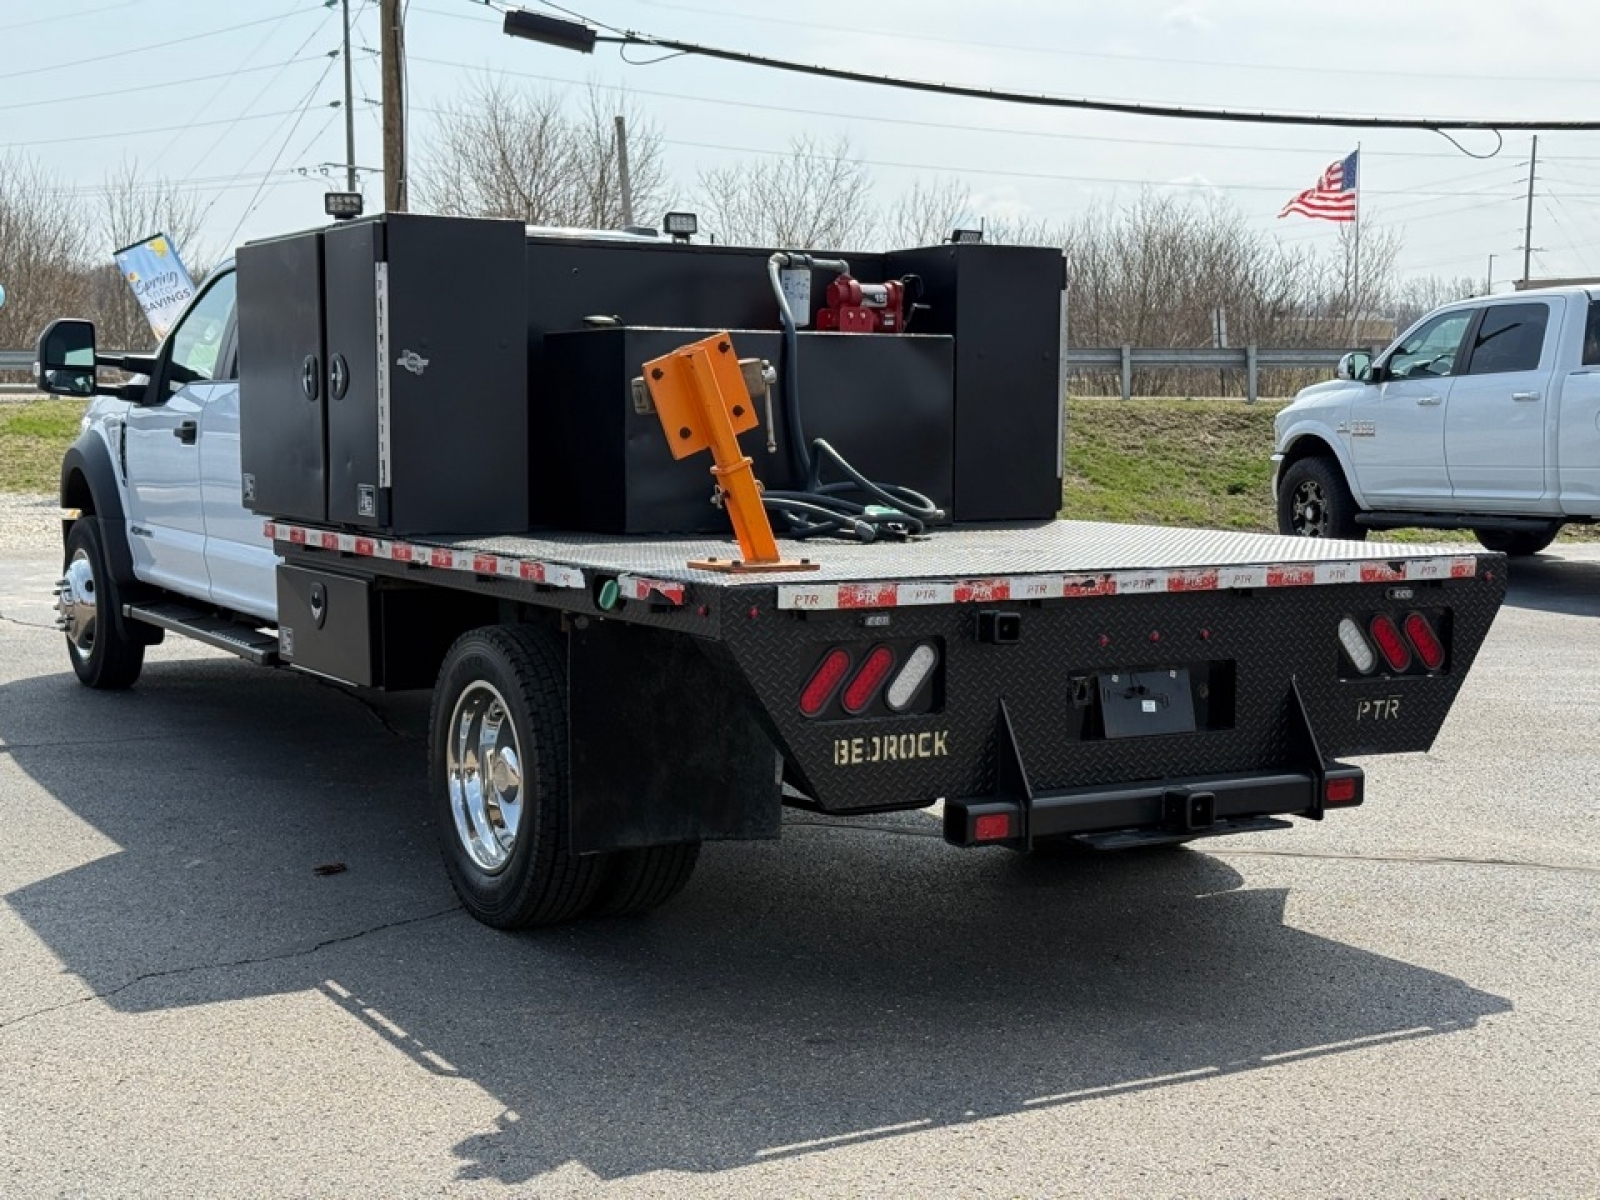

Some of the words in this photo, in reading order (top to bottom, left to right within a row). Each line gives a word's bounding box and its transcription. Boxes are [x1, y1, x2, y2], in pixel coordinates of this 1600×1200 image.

[135, 271, 179, 296] Spring
[143, 288, 191, 313] SAVINGS
[794, 594, 819, 607] PTR
[914, 589, 936, 600] PTR
[1026, 584, 1047, 595] PTR
[1234, 574, 1252, 584] PTR
[1329, 569, 1346, 579] PTR
[1356, 699, 1399, 720] PTR
[834, 730, 948, 765] BEDROCK
